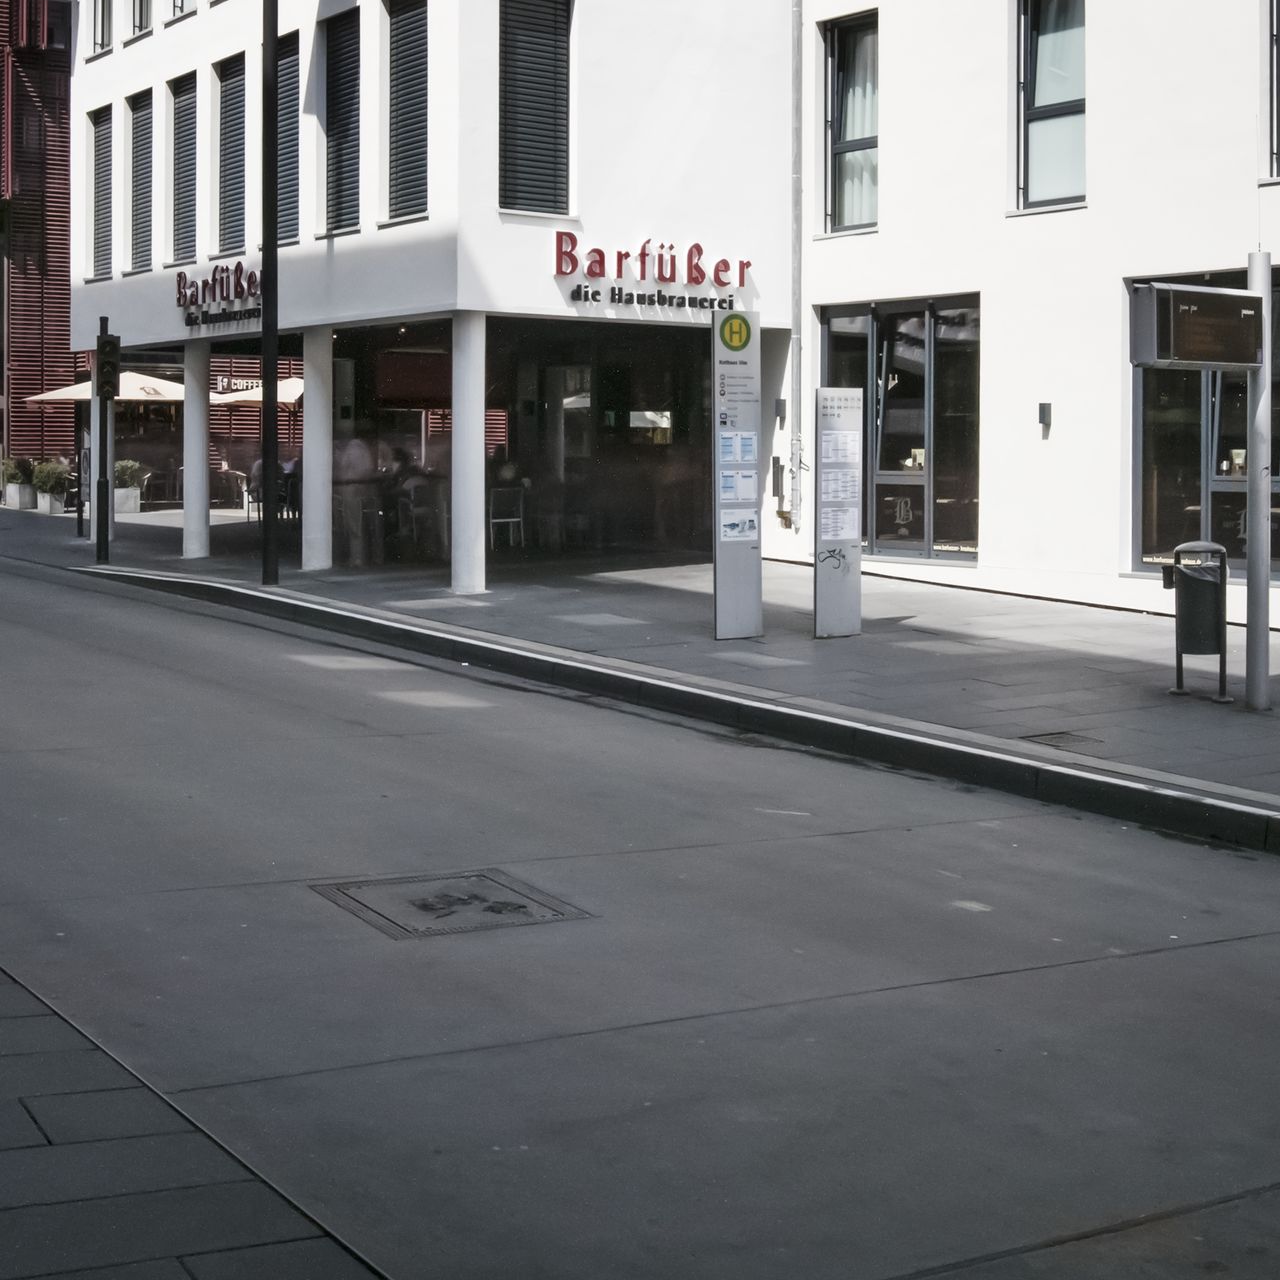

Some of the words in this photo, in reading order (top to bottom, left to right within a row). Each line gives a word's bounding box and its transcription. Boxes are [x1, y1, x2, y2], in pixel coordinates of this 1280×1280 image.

[555, 231, 752, 288] Barfüßer
[177, 261, 263, 307] Barfüße
[571, 284, 601, 303] die
[610, 287, 734, 310] Hausbrauerei
